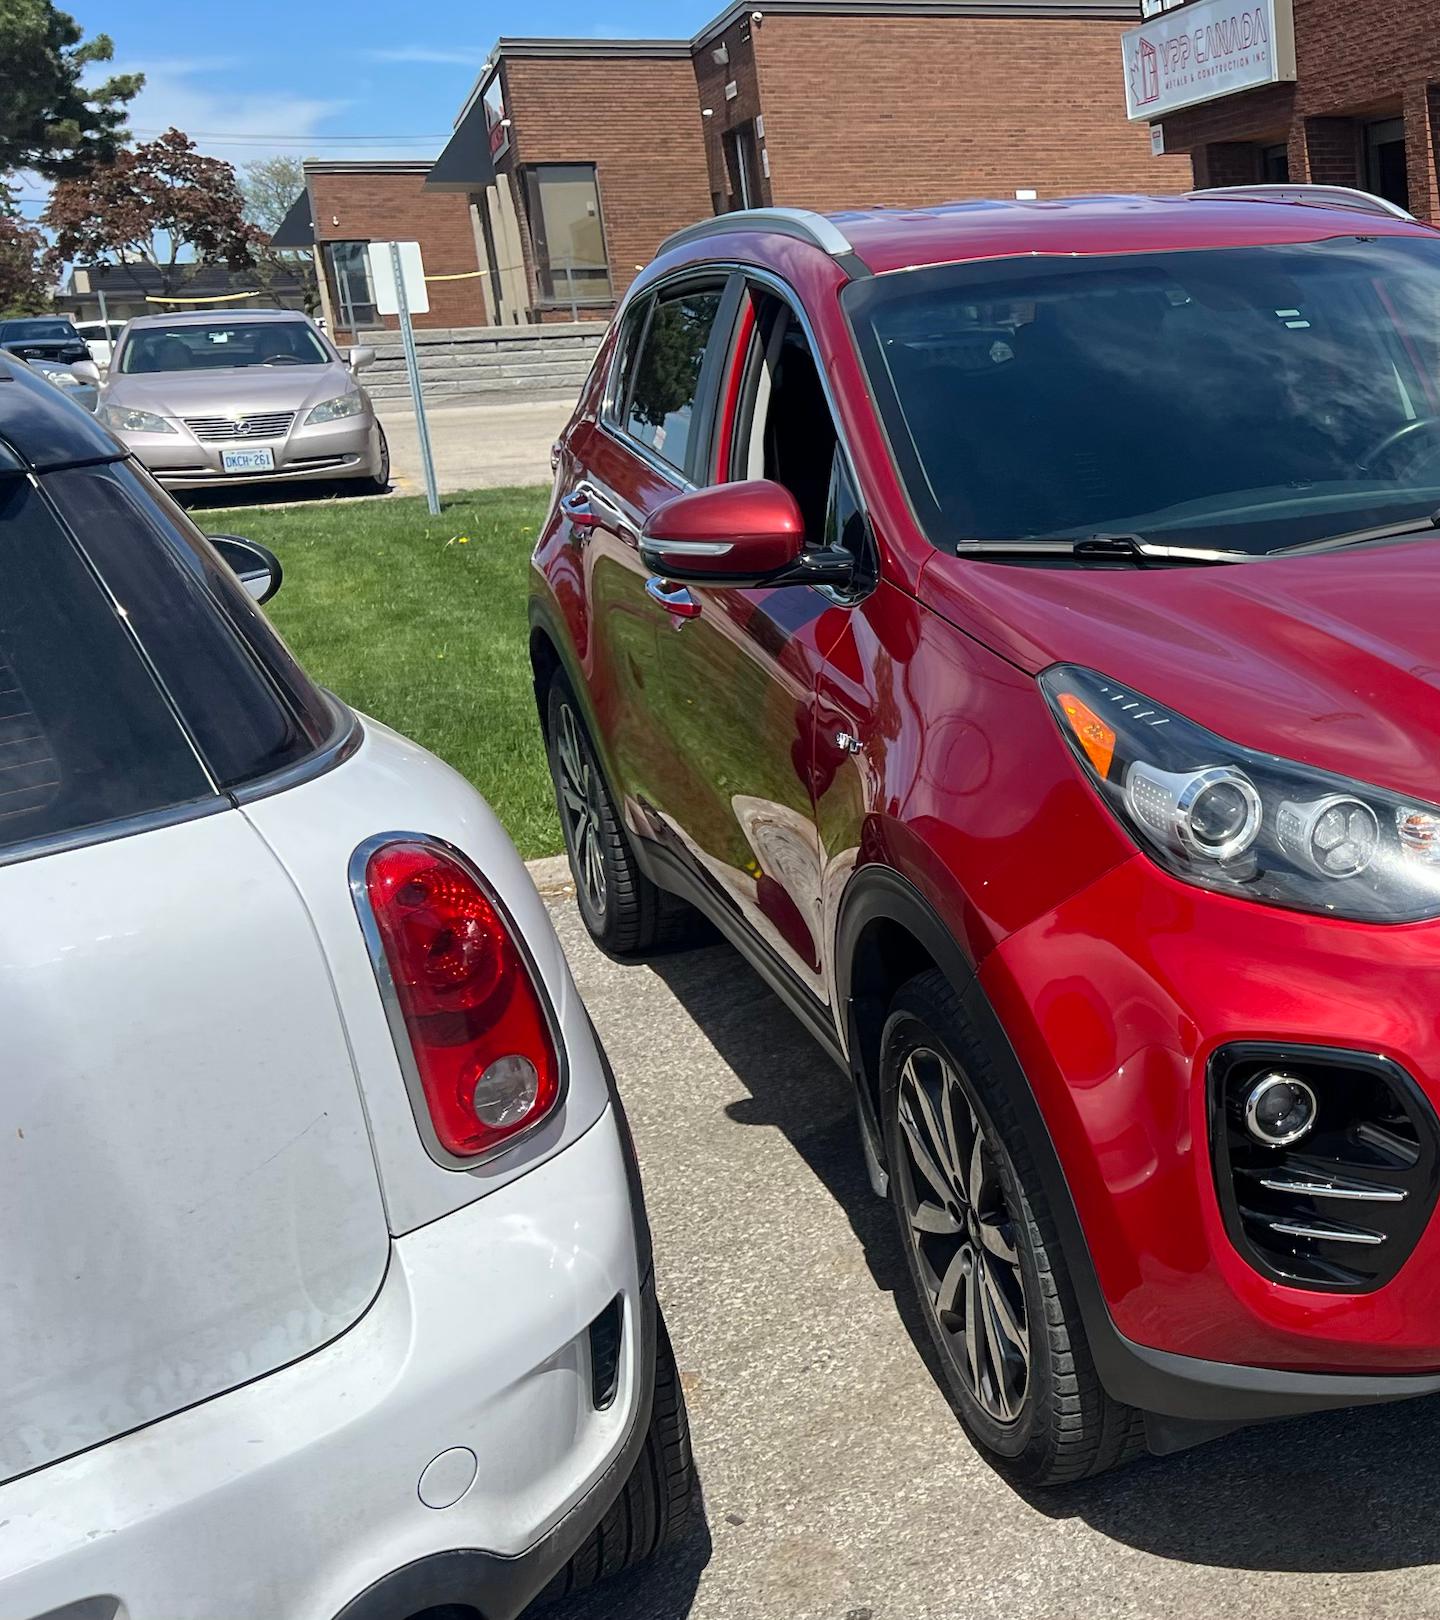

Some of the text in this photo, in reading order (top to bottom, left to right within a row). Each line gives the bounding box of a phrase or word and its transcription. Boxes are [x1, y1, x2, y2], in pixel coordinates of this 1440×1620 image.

[1193, 8, 1267, 64] CANADA
[1197, 56, 1249, 80] CONSTRUCTION
[1253, 51, 1266, 63] INC
